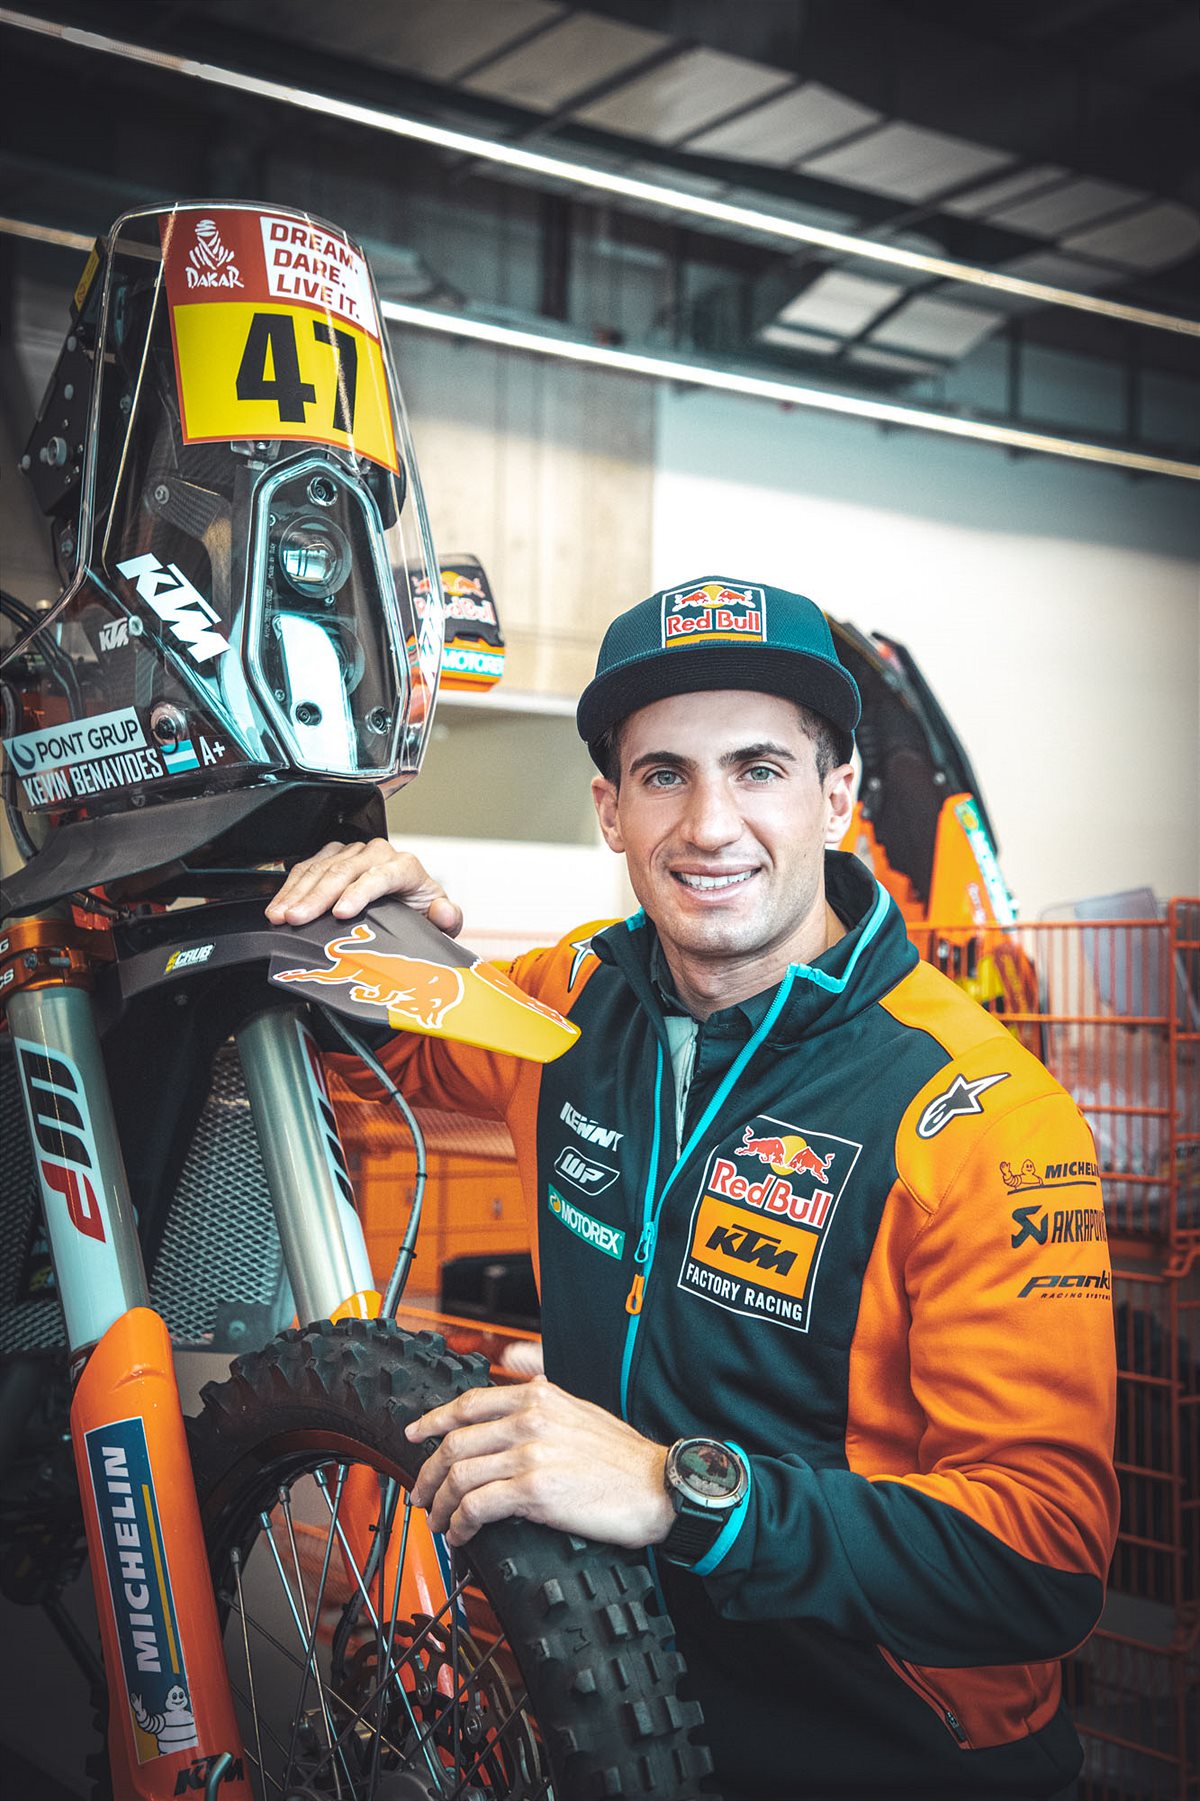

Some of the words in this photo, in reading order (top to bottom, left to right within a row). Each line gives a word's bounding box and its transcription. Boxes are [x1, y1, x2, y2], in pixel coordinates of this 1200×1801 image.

[185, 265, 244, 289] DAKAR
[273, 248, 346, 288] DARE.
[277, 274, 333, 305] LIVE
[236, 313, 358, 434] 47
[116, 553, 231, 663] KTM
[667, 609, 712, 636] Red
[716, 610, 760, 632] Bull
[99, 617, 129, 652] KTM
[35, 732, 83, 763] PONT
[87, 719, 139, 750] GRUP
[199, 736, 226, 766] A+
[22, 770, 73, 807] KEVIN
[69, 749, 164, 796] BENAVIDES
[709, 1160, 774, 1206] Red
[766, 1180, 832, 1227] Bull
[561, 1200, 620, 1255] MOTOREX
[705, 1223, 799, 1277] KTM
[686, 1263, 741, 1301] FACTORY
[744, 1288, 803, 1322] RACING
[1041, 1292, 1082, 1300] RACING
[102, 1446, 162, 1673] MICHELIN
